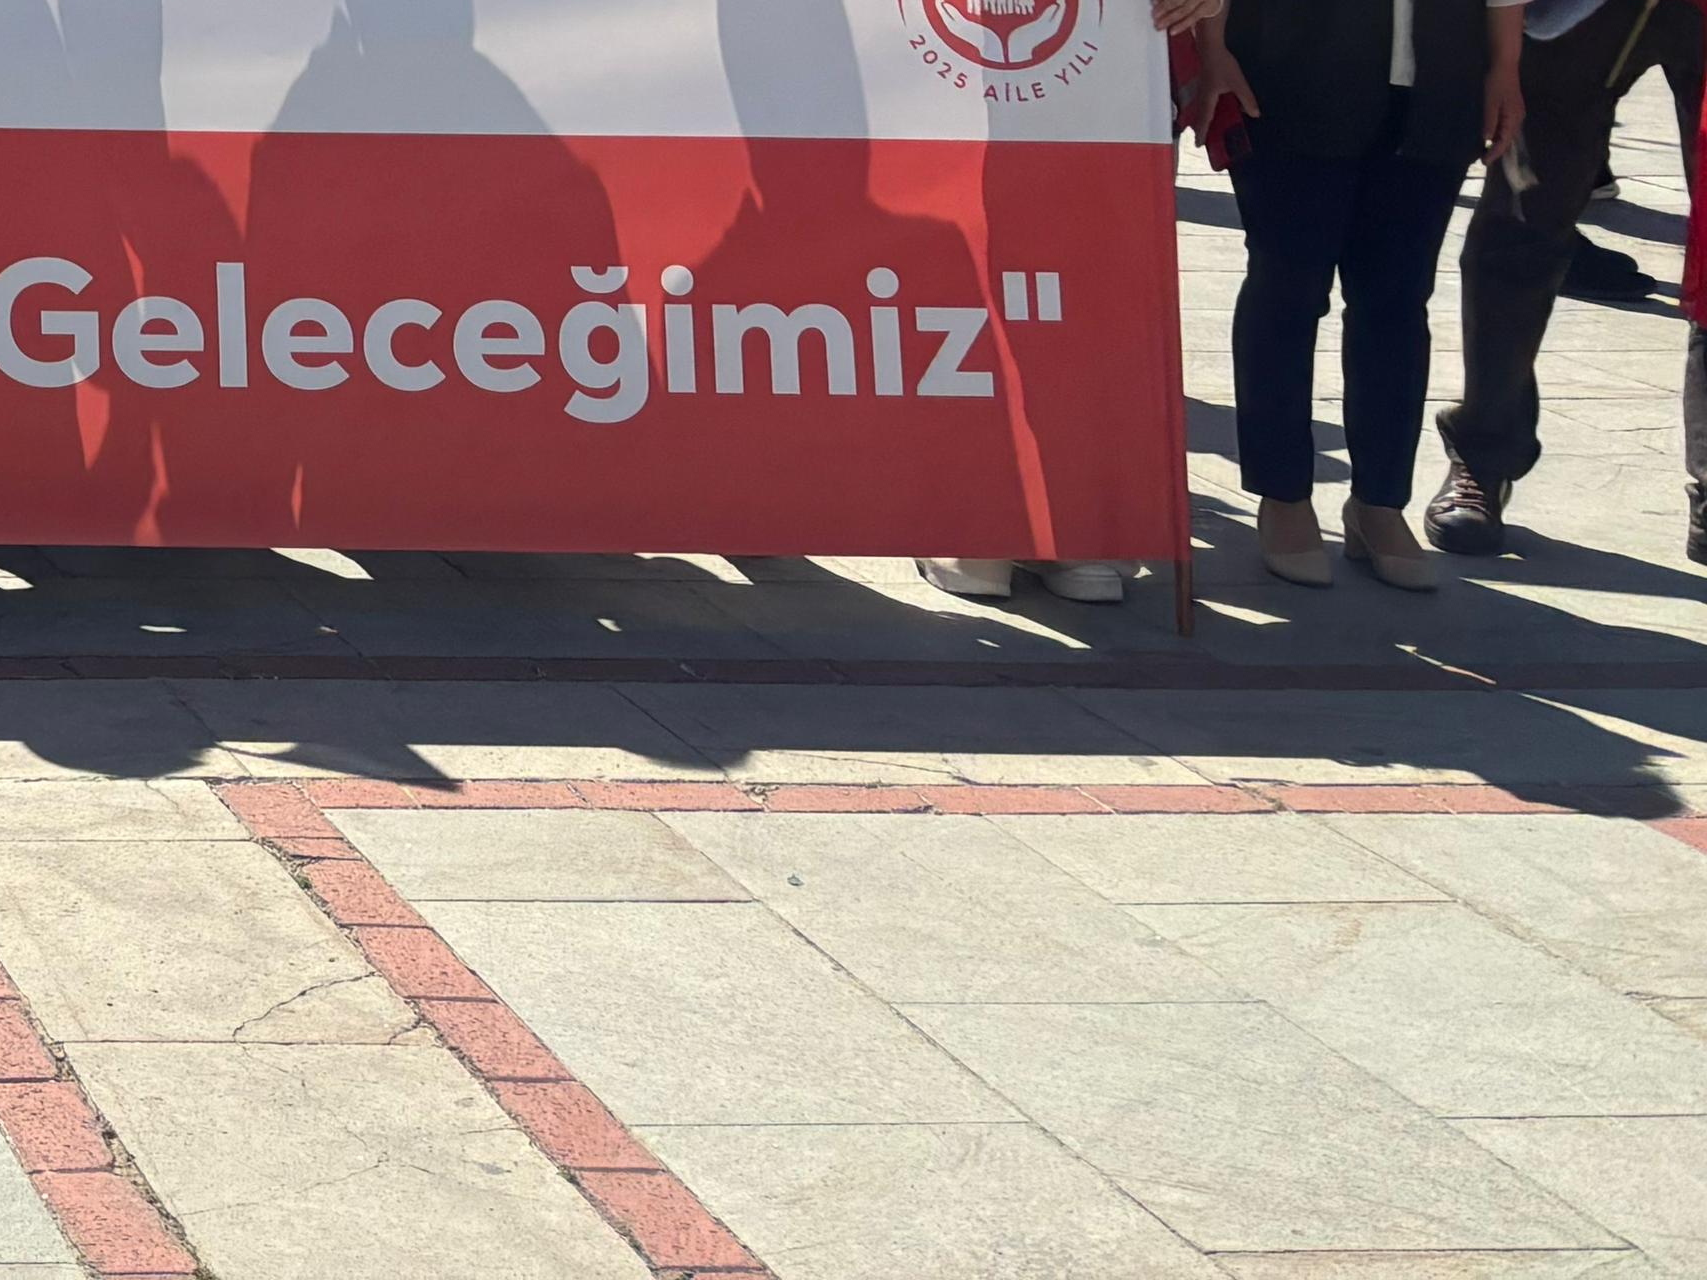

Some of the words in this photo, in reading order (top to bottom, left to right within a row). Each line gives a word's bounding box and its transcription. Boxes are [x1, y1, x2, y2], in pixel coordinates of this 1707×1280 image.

[909, 34, 968, 90] 2025
[983, 82, 1047, 103] AİLE
[1055, 40, 1099, 86] YILI
